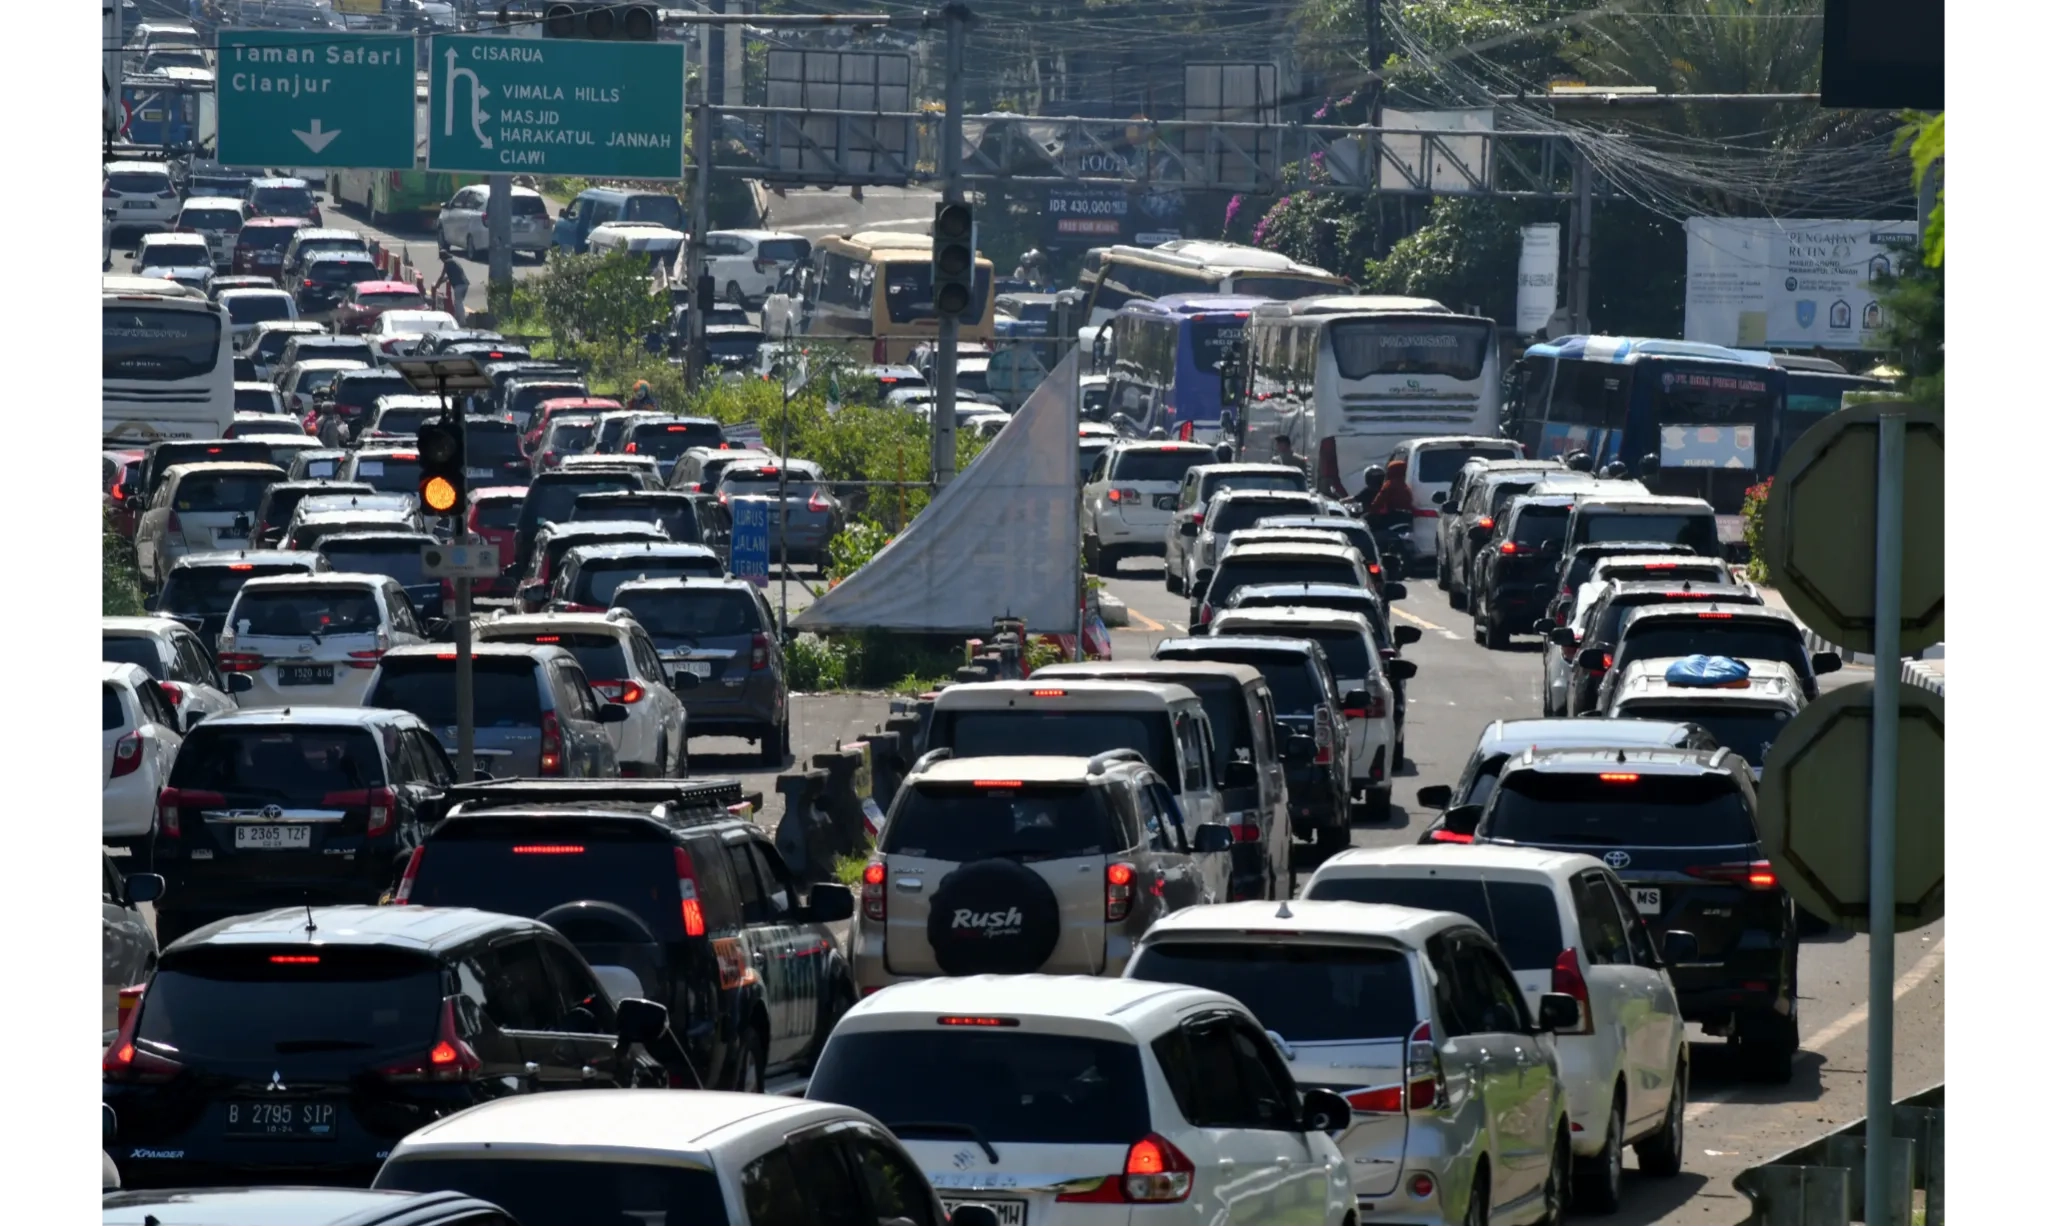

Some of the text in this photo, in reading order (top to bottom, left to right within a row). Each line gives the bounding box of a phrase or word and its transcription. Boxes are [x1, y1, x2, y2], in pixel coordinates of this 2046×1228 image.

[232, 43, 401, 65] Taman Safari
[472, 46, 544, 63] CISARUA
[232, 73, 331, 98] Cianjur
[502, 84, 620, 102] VIMALA HILLS
[501, 109, 560, 125] MASJID
[501, 128, 671, 148] HARAKATUL JANNAH
[500, 150, 545, 165] CIAWI
[1049, 199, 1067, 213] IDR
[1070, 200, 1111, 214] 430,000
[1789, 231, 1857, 245] PENGAJIAN
[734, 535, 766, 552] JALAN
[735, 560, 764, 577] TERUS
[238, 827, 307, 841] B 2365 TZF
[1637, 891, 1658, 904] MS
[951, 906, 1022, 928] Rush
[229, 1104, 333, 1123] B 2795 SIP
[130, 1148, 184, 1159] XPANDER
